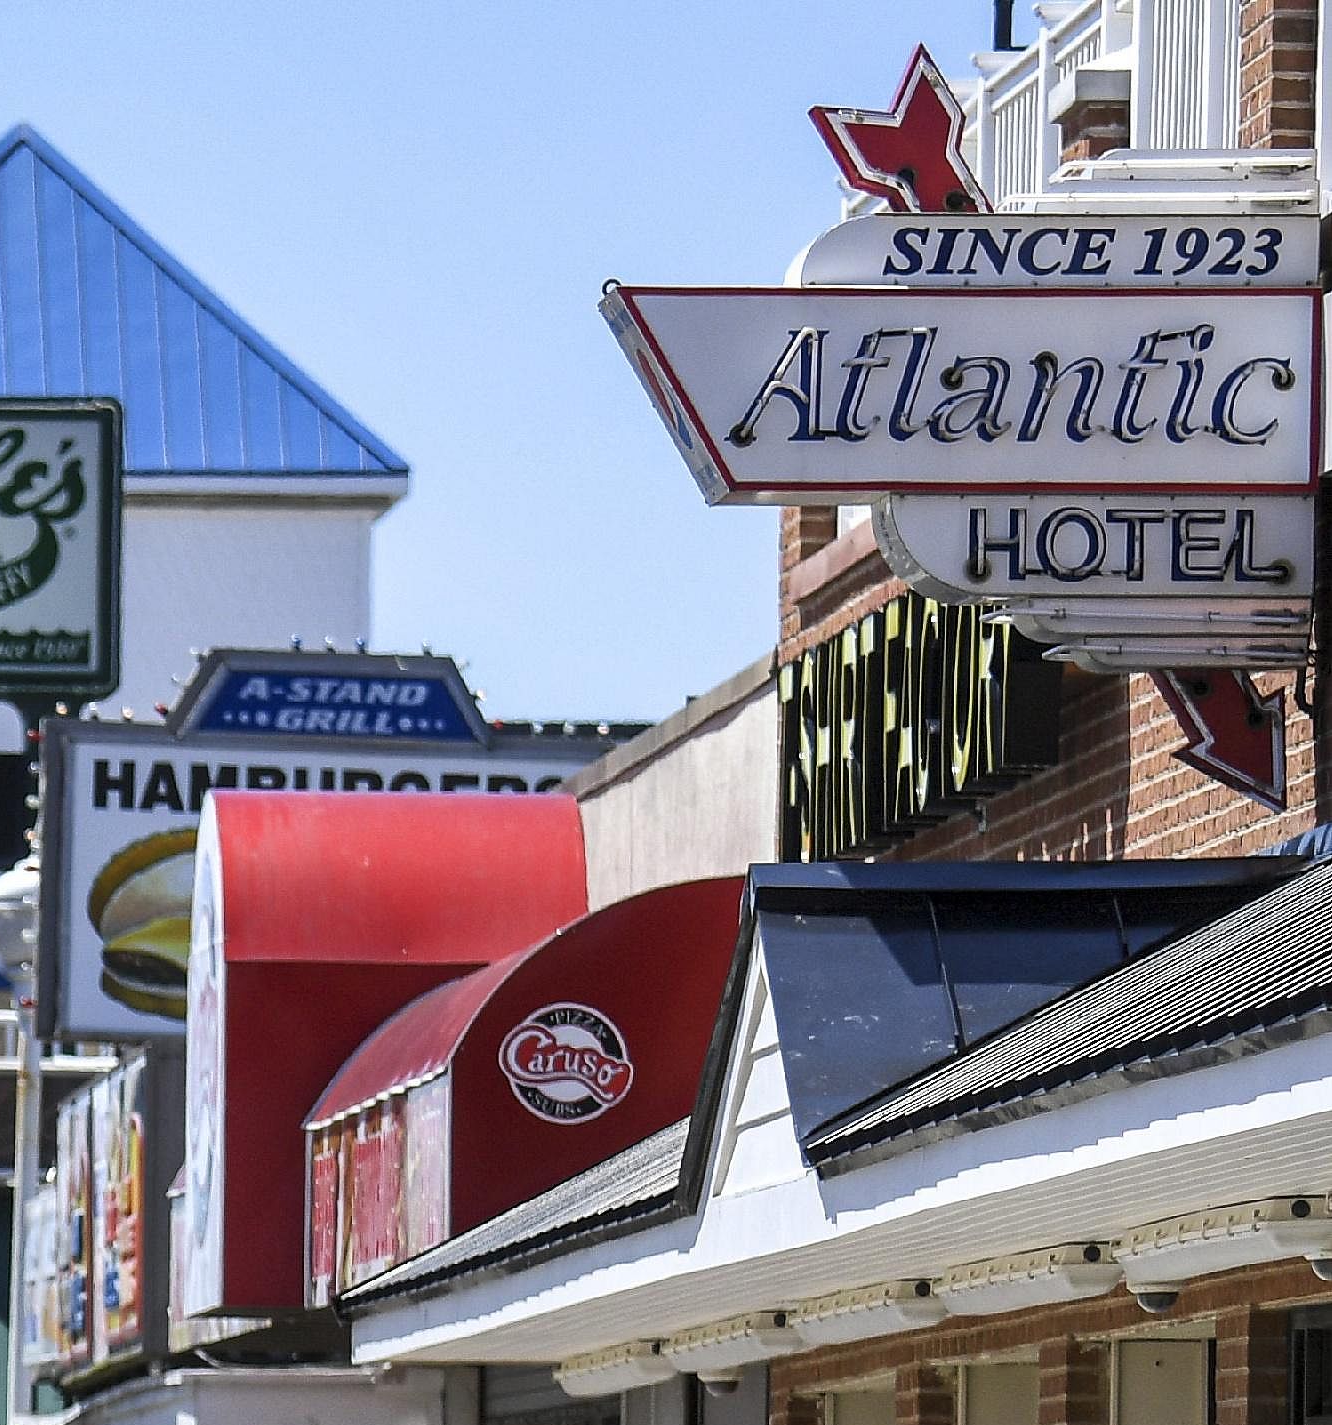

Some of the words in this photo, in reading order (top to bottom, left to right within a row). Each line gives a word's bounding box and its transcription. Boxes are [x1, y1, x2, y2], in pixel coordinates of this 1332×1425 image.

[882, 227, 1116, 276] SINCE
[1134, 227, 1284, 276] 1923
[725, 323, 1296, 447] Atlantic
[966, 507, 1295, 583] HOTEL
[238, 677, 428, 706] A-STAND
[274, 709, 394, 735] GRILL
[507, 1031, 624, 1095] Caruso
